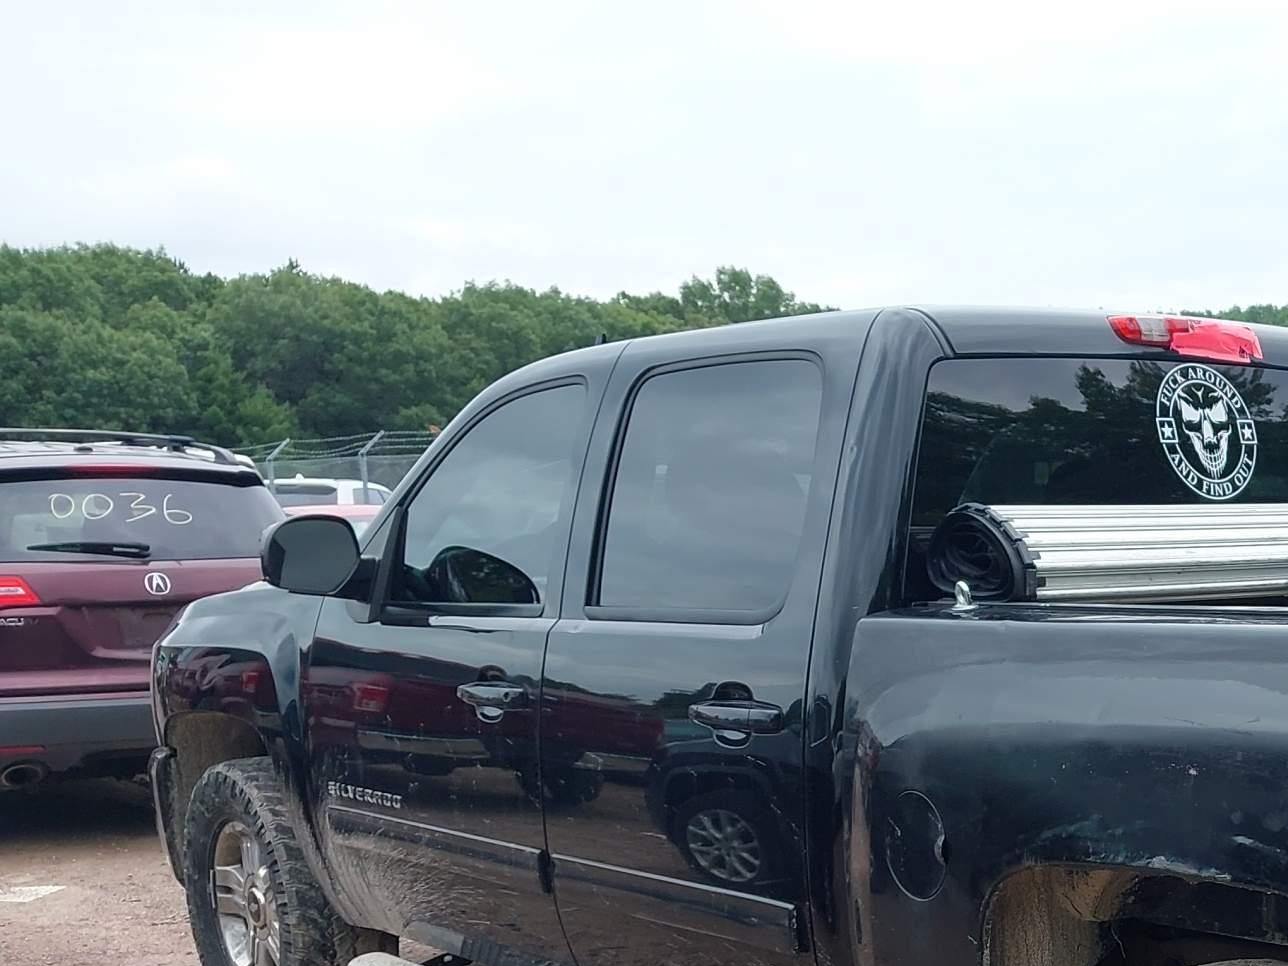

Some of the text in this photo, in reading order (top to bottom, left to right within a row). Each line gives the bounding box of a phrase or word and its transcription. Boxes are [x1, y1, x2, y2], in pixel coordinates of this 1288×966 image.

[1161, 367, 1241, 409] FUCK AROUND
[1170, 453, 1263, 497] AND FIND OUT
[48, 493, 193, 525] 0036
[327, 781, 403, 809] SILVERADO
